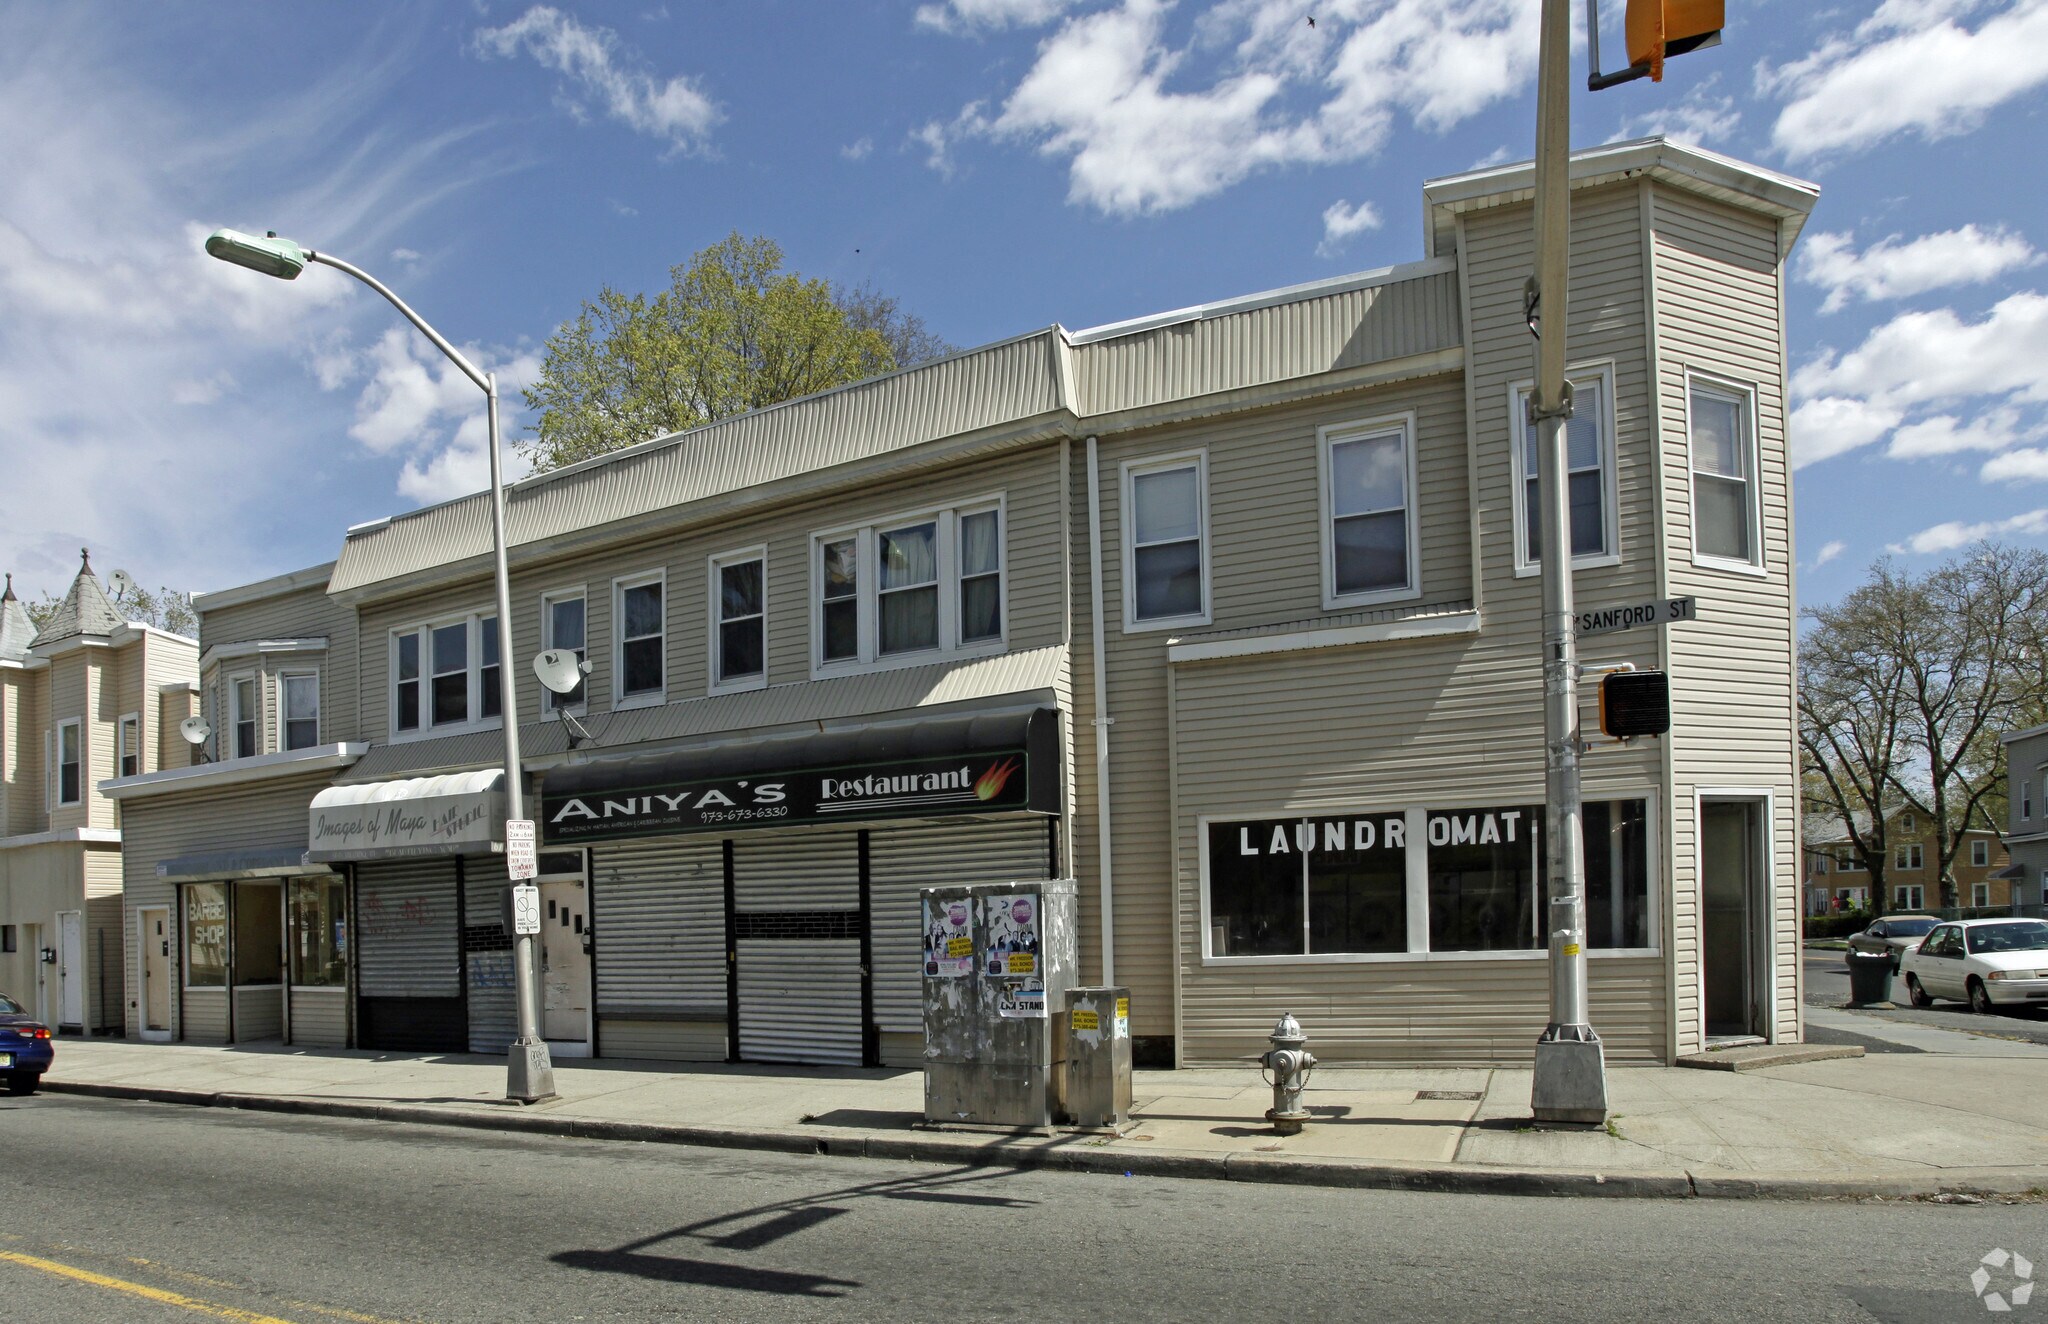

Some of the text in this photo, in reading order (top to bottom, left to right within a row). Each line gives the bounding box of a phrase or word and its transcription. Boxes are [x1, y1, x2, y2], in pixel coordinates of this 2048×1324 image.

[1582, 600, 1688, 630] SANFORD ST
[822, 765, 972, 799] Restaurant
[550, 781, 787, 823] ANIYA'S
[700, 806, 788, 824] 973-673-6330
[315, 808, 428, 843] Images of Maya
[1240, 811, 1521, 856] LAUNDROMAT
[189, 901, 226, 921] BARBE
[195, 925, 225, 944] SHOP
[1019, 1001, 1044, 1010] STAND
